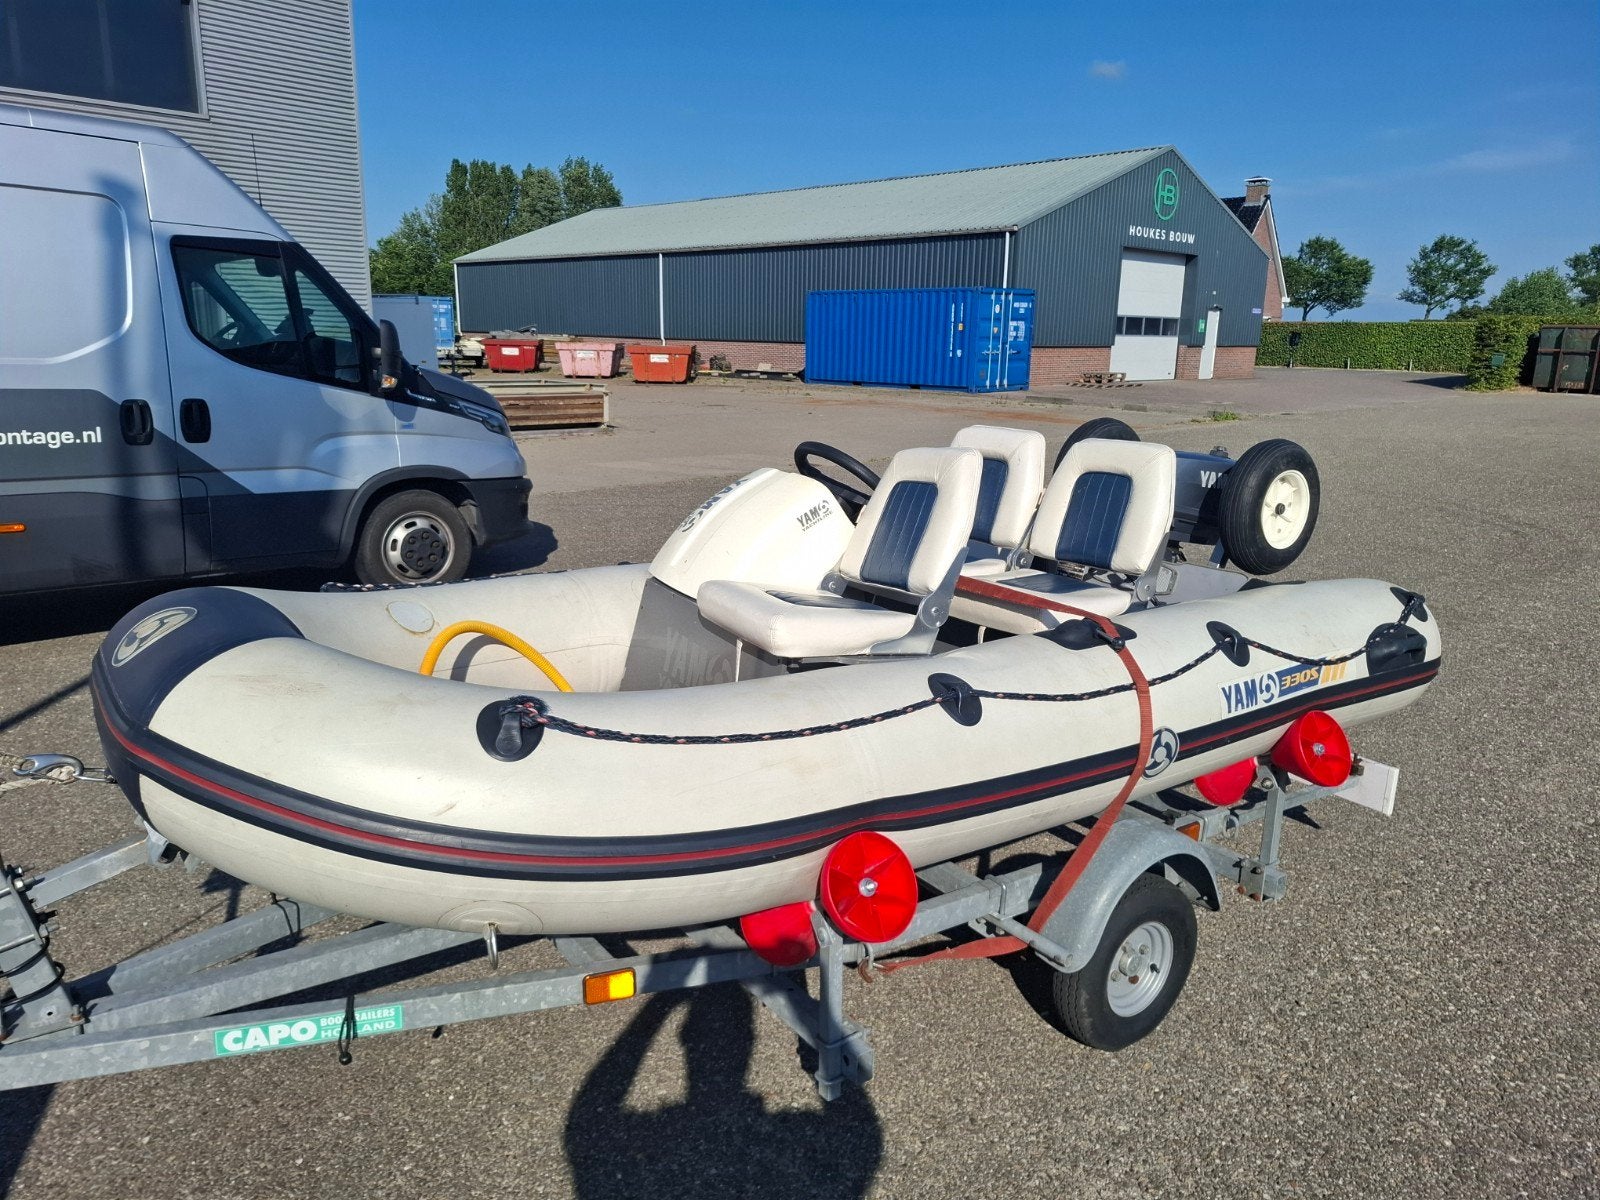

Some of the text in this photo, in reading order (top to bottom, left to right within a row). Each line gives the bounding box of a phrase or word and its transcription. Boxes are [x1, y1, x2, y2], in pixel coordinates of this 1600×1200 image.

[1129, 225, 1195, 244] HOUKES BOUW
[1200, 470, 1223, 489] YA
[1221, 666, 1320, 714] YAM 330S
[222, 1020, 318, 1051] CAPO
